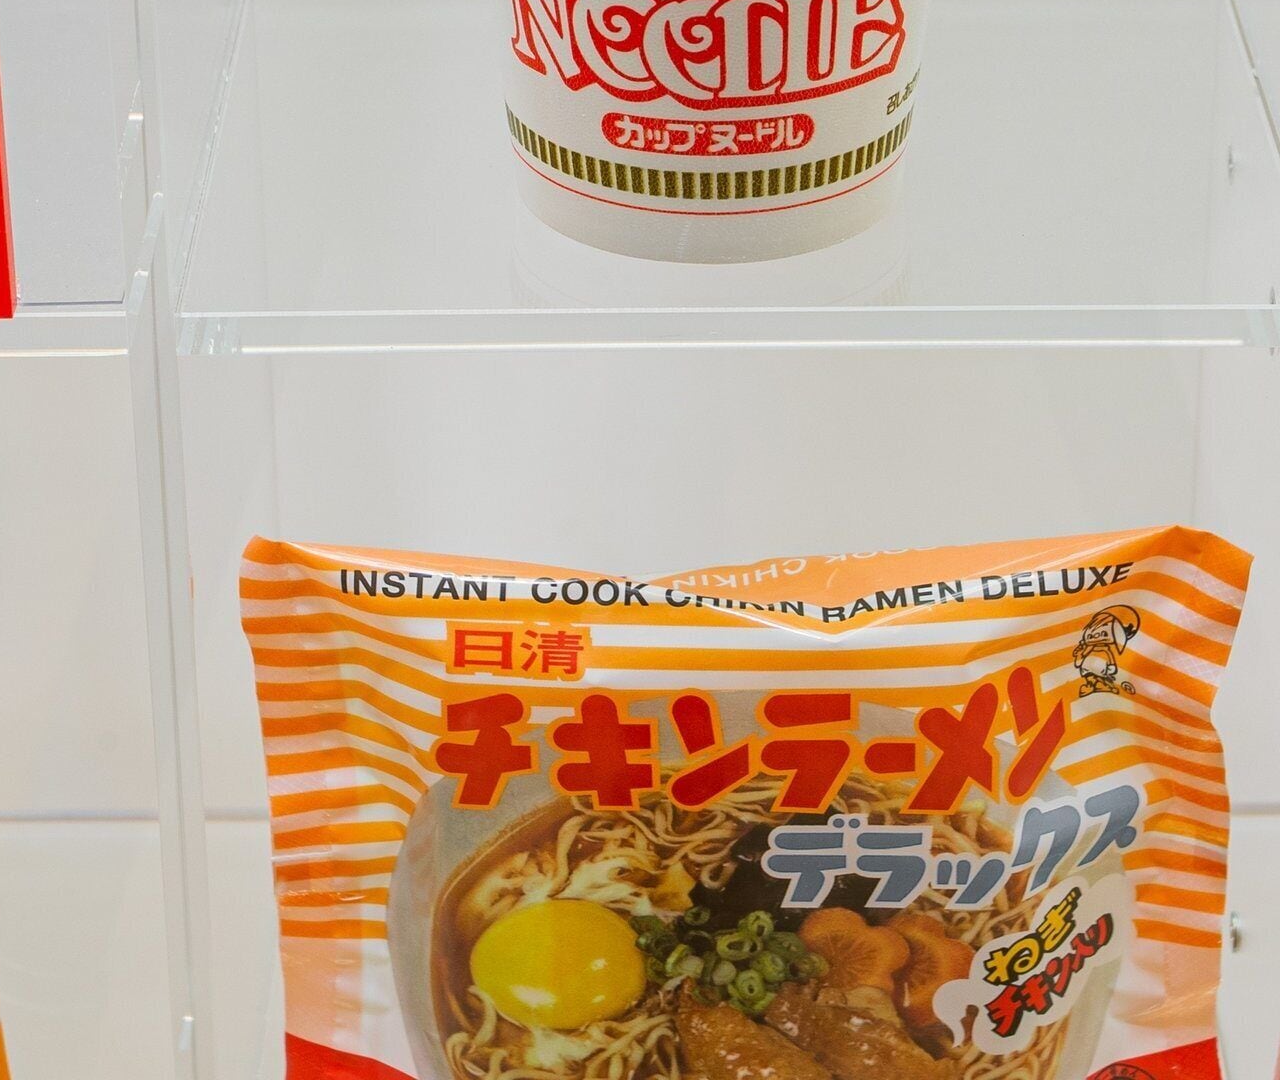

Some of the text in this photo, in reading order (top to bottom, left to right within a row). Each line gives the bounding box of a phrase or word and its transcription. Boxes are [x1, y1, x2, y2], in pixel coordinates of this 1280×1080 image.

[615, 115, 805, 153] カップヌードル
[339, 568, 511, 604] INSTANT
[530, 574, 648, 608] COOK
[821, 580, 965, 624] RAMEN
[982, 561, 1134, 601] DELUXE
[452, 628, 586, 677] 日清
[435, 666, 1068, 812] チキンラーメン
[771, 787, 1138, 902] デラックス
[983, 886, 1082, 985] ねぎ
[984, 913, 1114, 1038] チキン入り
